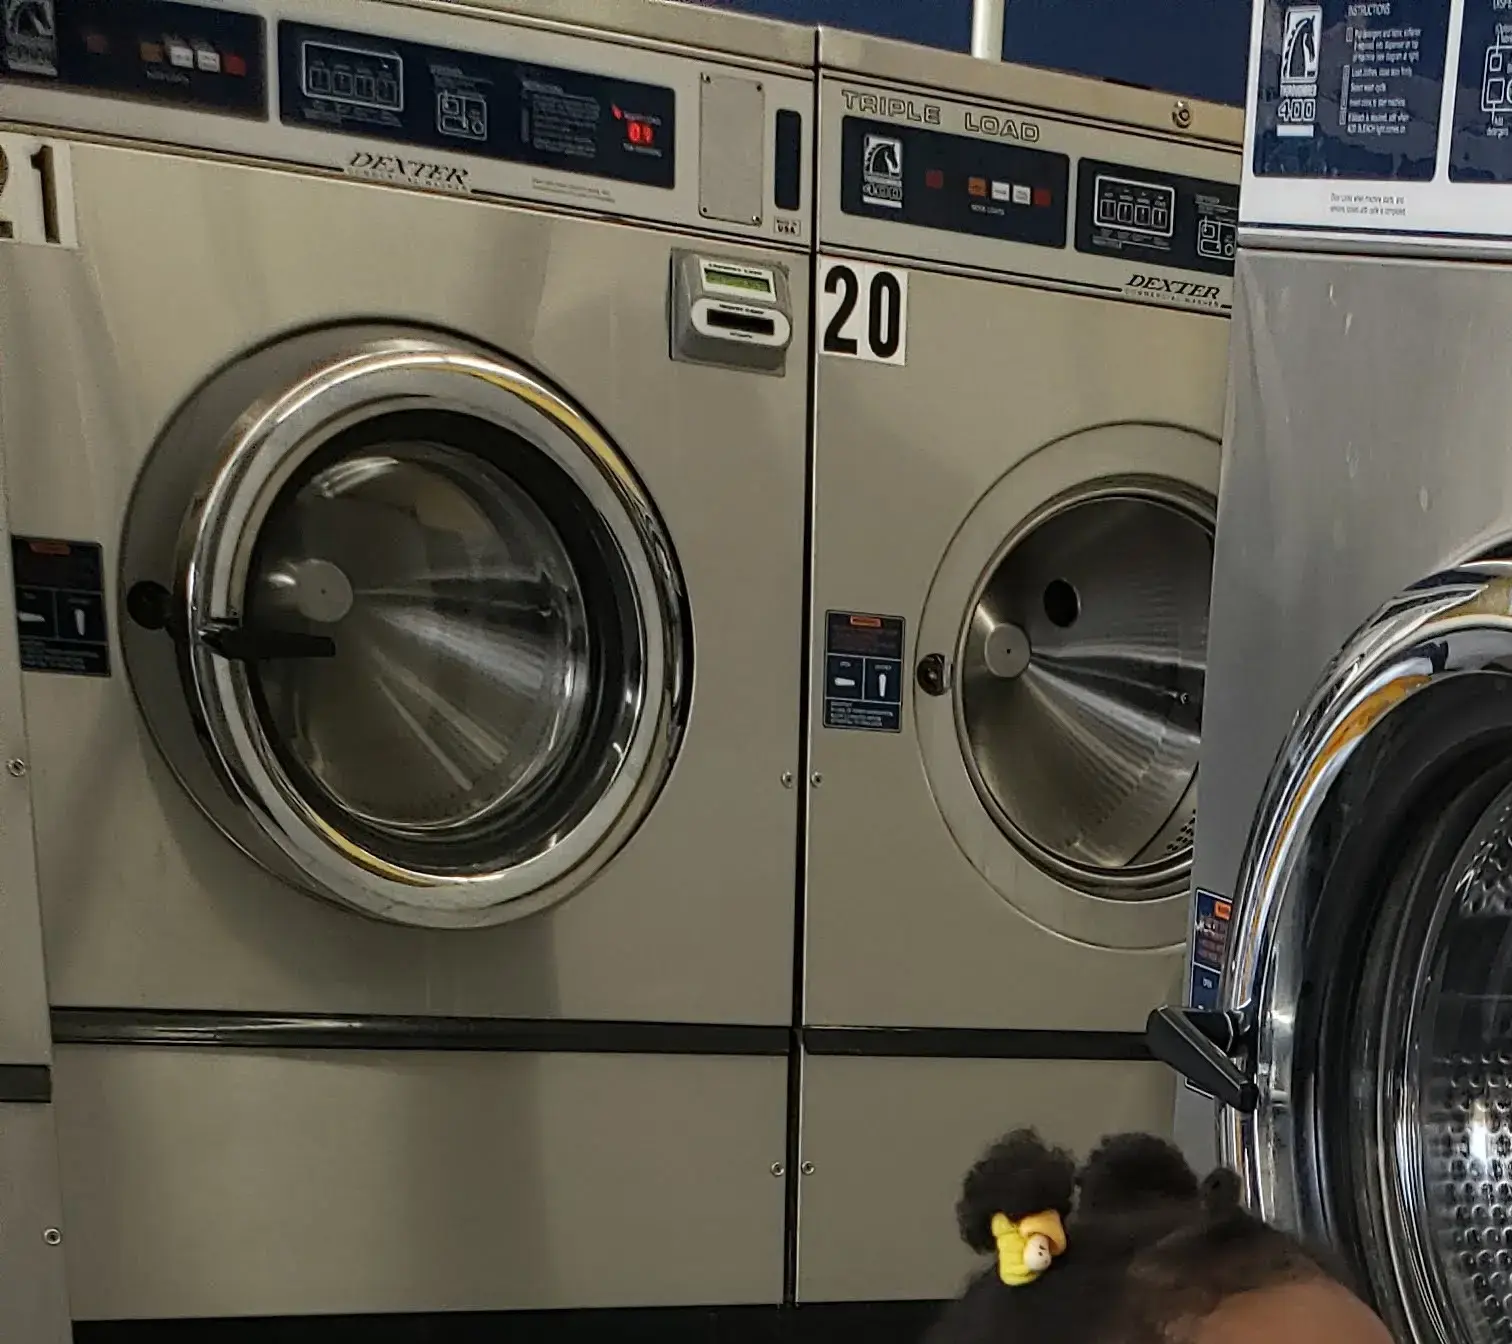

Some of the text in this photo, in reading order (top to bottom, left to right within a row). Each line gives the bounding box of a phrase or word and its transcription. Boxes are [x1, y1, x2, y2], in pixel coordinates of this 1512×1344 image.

[841, 89, 1040, 144] TRIPLE LOAD
[1278, 98, 1316, 122] 400
[350, 152, 469, 185] DEXTER
[0, 145, 60, 243] 1
[1125, 274, 1220, 299] DEXTER
[824, 265, 901, 358] 20
